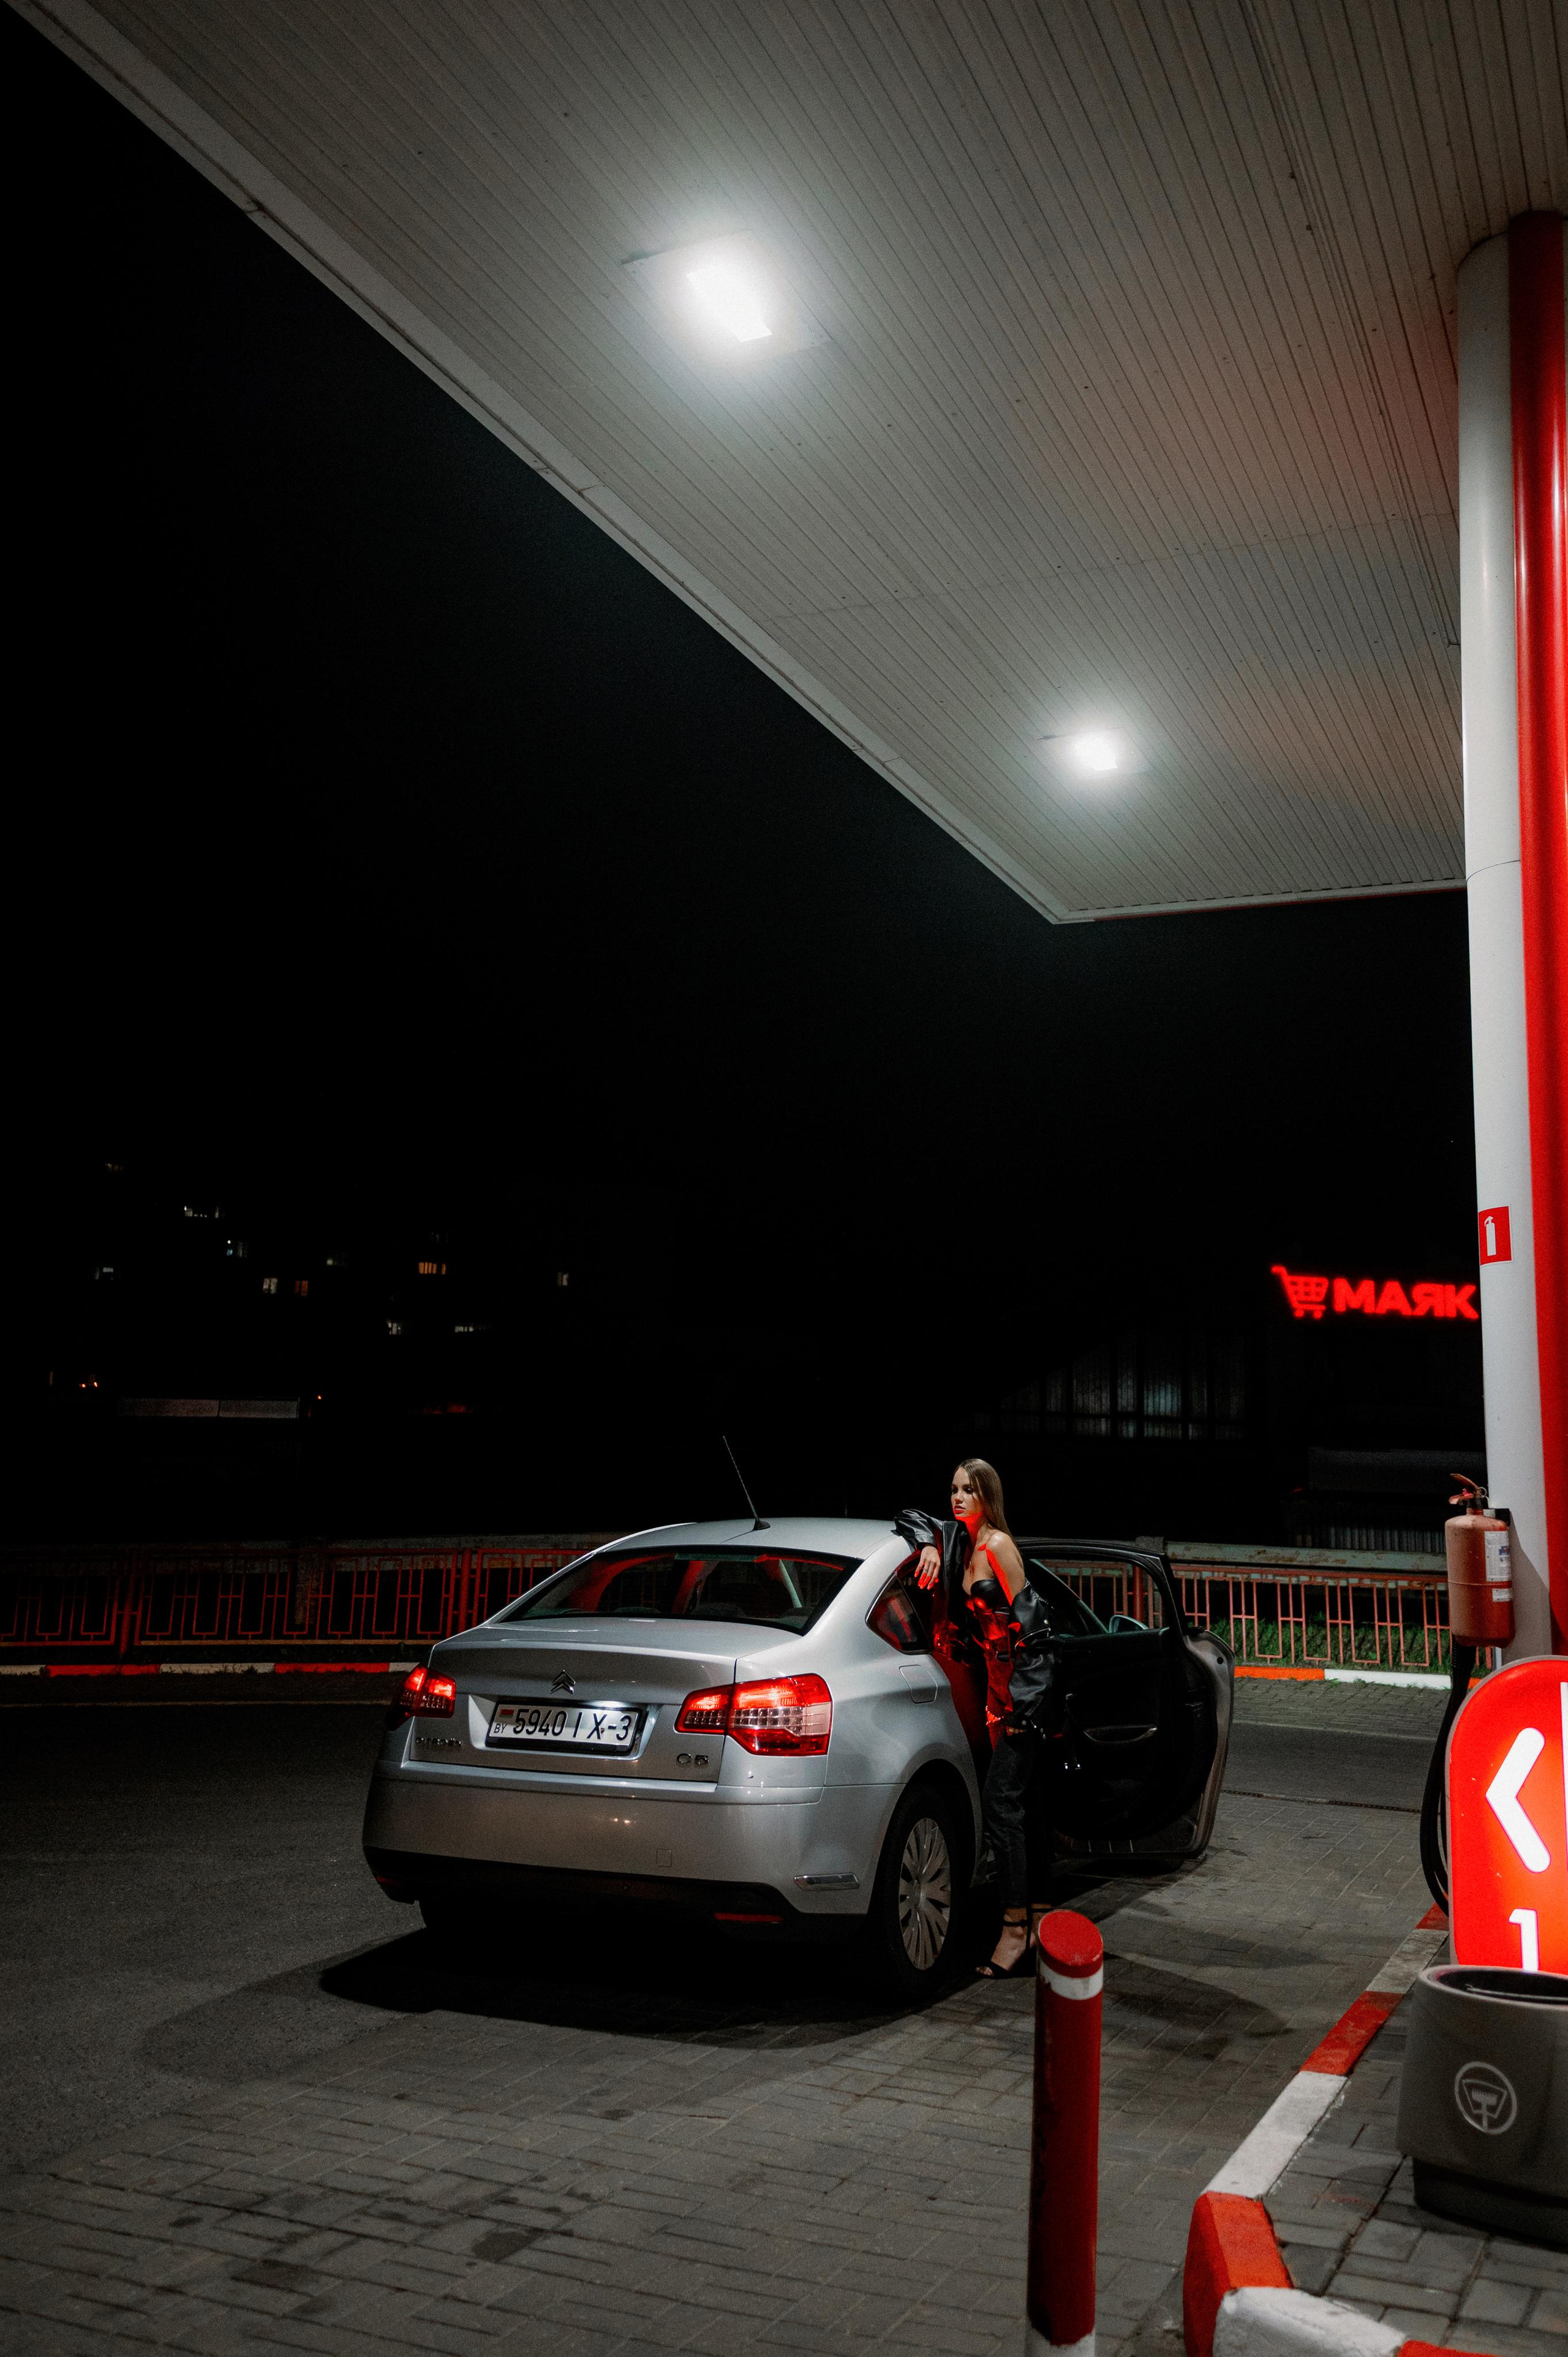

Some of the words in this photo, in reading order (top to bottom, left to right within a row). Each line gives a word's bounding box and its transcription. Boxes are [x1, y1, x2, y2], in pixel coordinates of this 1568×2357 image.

[1333, 1277, 1479, 1318] МАЯК
[493, 1723, 507, 1734] BY
[513, 1708, 568, 1736] 5940
[676, 1753, 709, 1765] C5
[1509, 1908, 1539, 1973] 1
